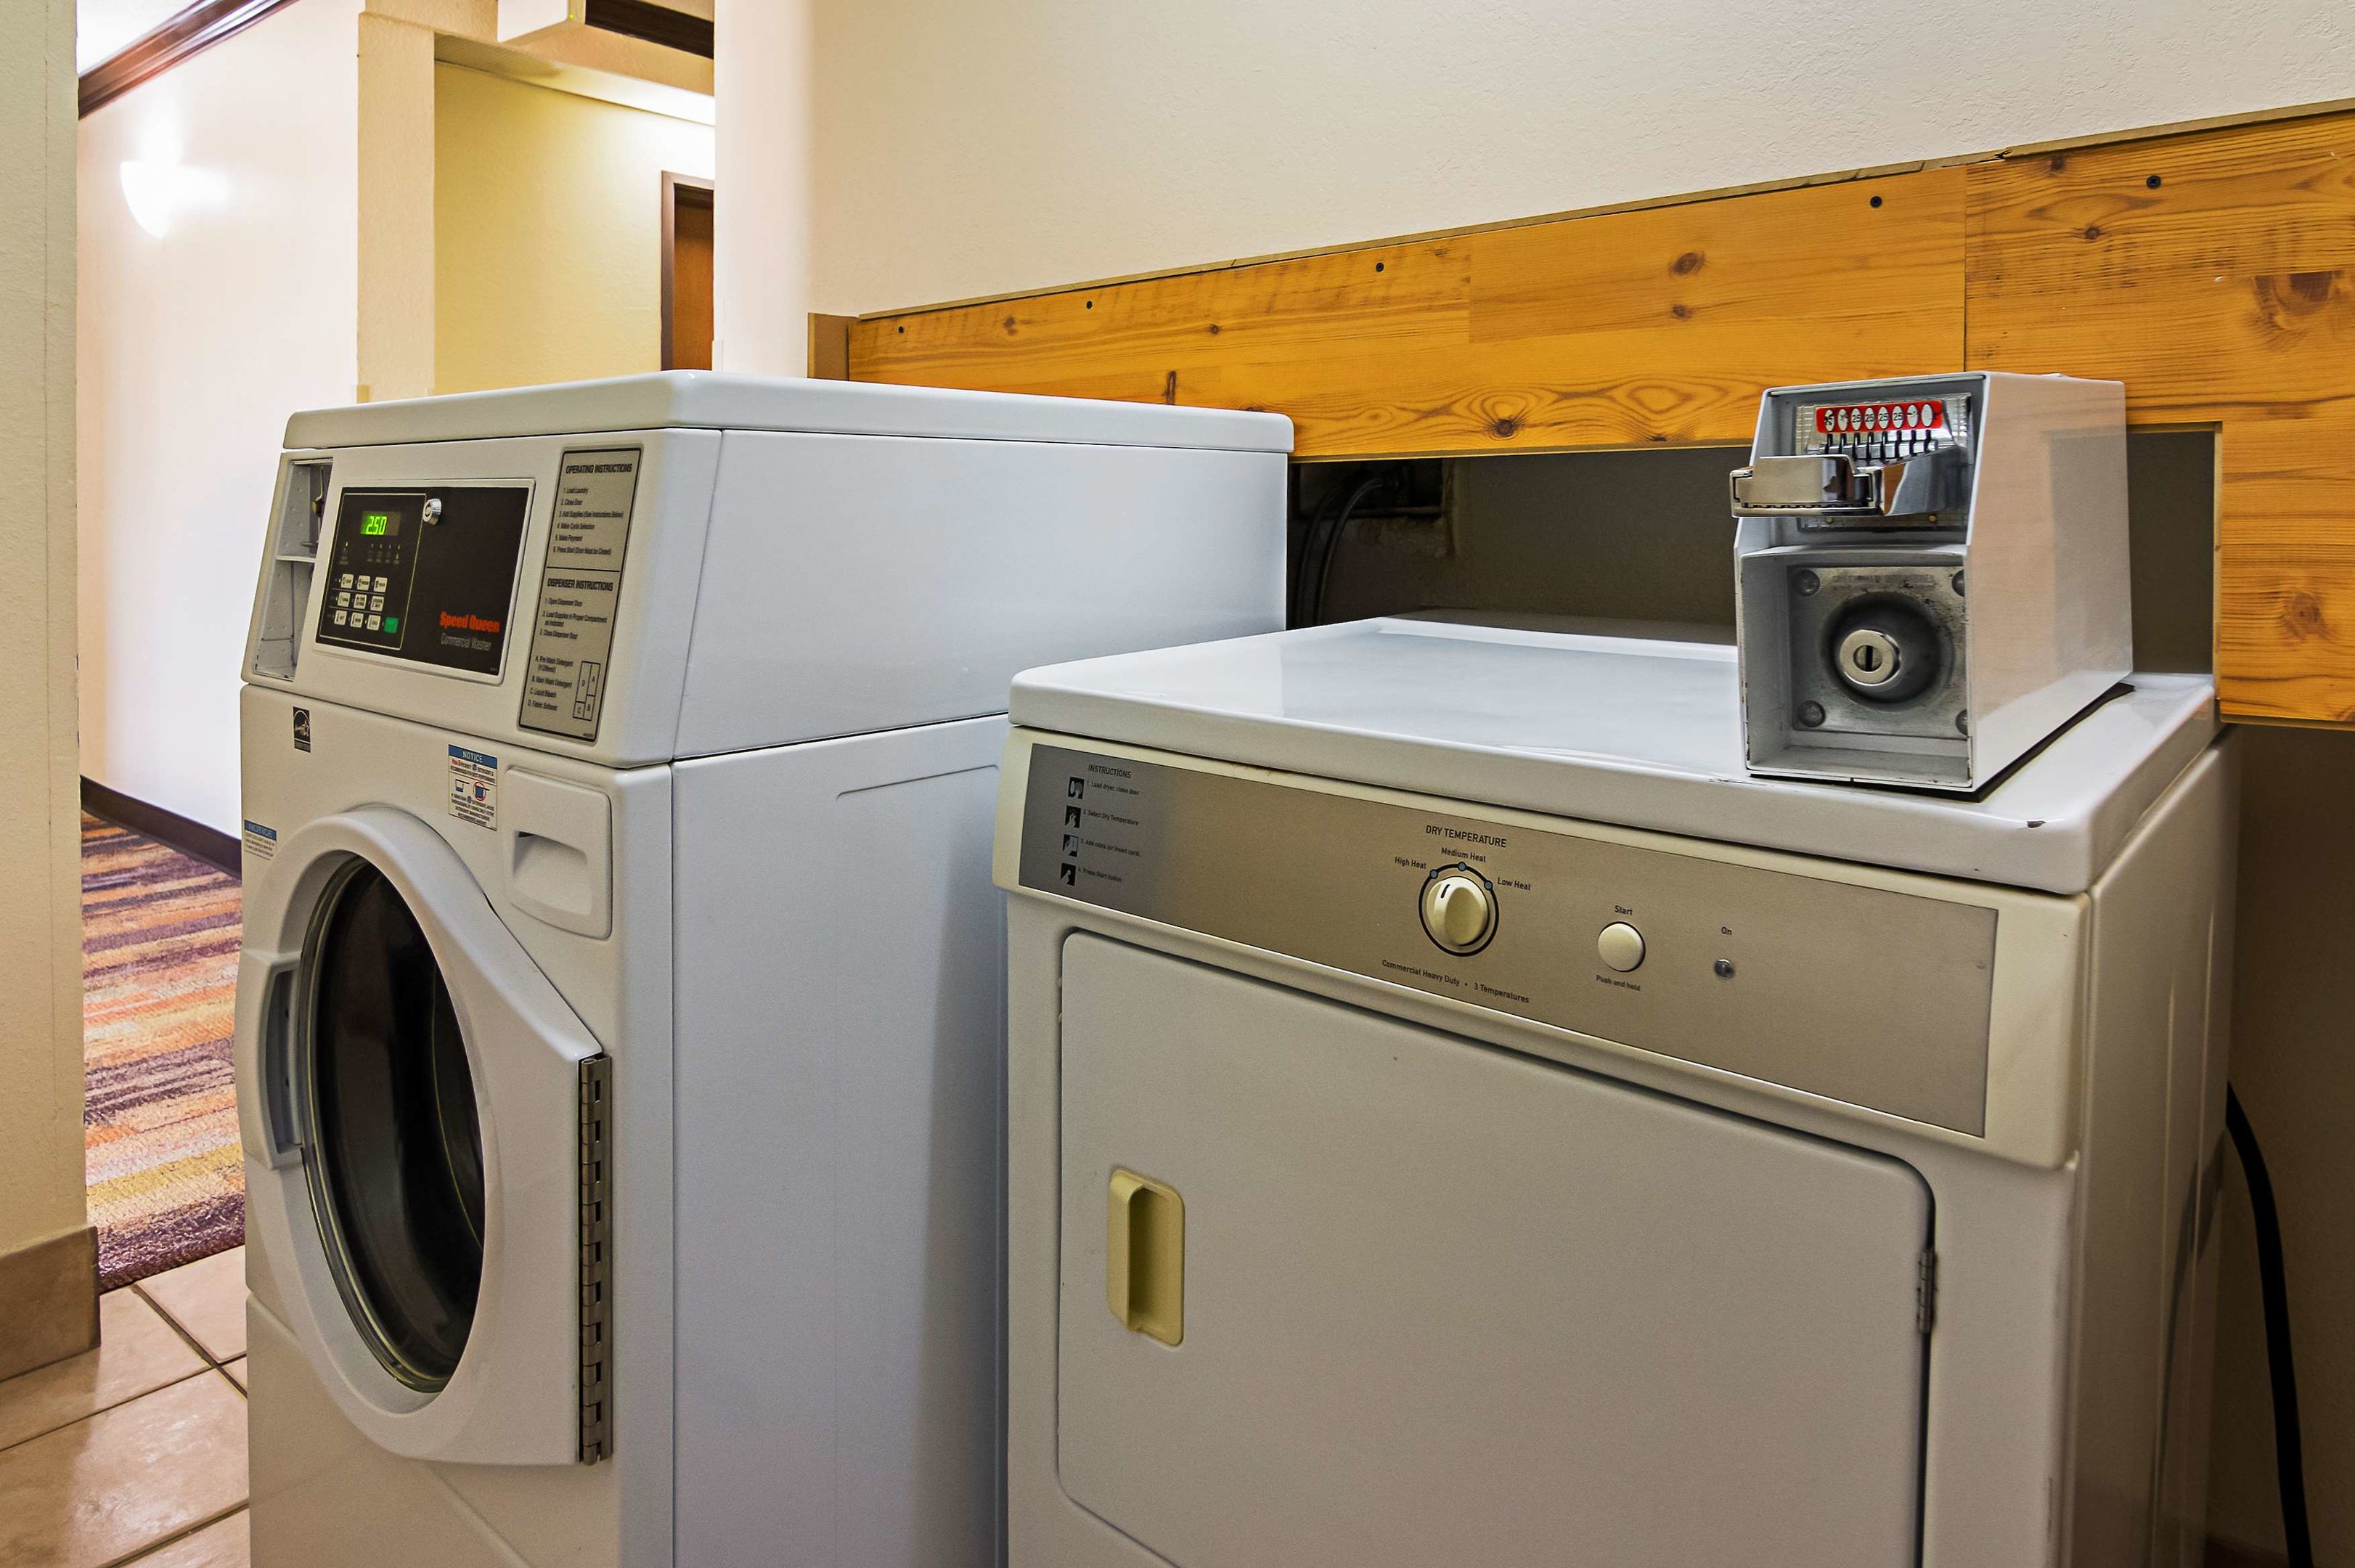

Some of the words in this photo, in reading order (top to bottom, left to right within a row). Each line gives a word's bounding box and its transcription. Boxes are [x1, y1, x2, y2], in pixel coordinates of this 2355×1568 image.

[1879, 413, 1888, 422] 25
[1893, 412, 1903, 421] 25
[566, 465, 594, 473] OPERATING
[595, 463, 632, 473] INSTRUCTIONS
[366, 516, 388, 535] 250
[547, 578, 575, 588] DISPENSER
[576, 579, 613, 592] INSTRUCTIONS
[440, 611, 470, 629] Speed
[469, 614, 500, 633] Queen
[441, 632, 470, 648] Commercial
[471, 638, 491, 651] Washer
[462, 751, 483, 763] NOTICE
[1088, 764, 1132, 779] INSTRUCTIONS
[1111, 814, 1138, 826] Temperature
[248, 823, 273, 838] NOTICE
[1426, 825, 1442, 836] DRY
[1444, 828, 1507, 848] TEMPERATURE
[1441, 847, 1468, 859] Medium
[1470, 852, 1486, 862] Heat
[1395, 856, 1410, 867] High
[1411, 859, 1427, 870] Heat
[1096, 870, 1107, 879] Start
[1498, 877, 1513, 886] Low
[1514, 881, 1531, 891] Heat
[1615, 905, 1633, 915] Start
[1721, 926, 1732, 935] On
[1381, 959, 1421, 976] Commercial
[1422, 970, 1443, 982] Heavy
[1444, 975, 1460, 987] Duty
[1480, 984, 1530, 1003] Temperatures
[1596, 974, 1612, 984] Push
[1626, 981, 1641, 992] hold
